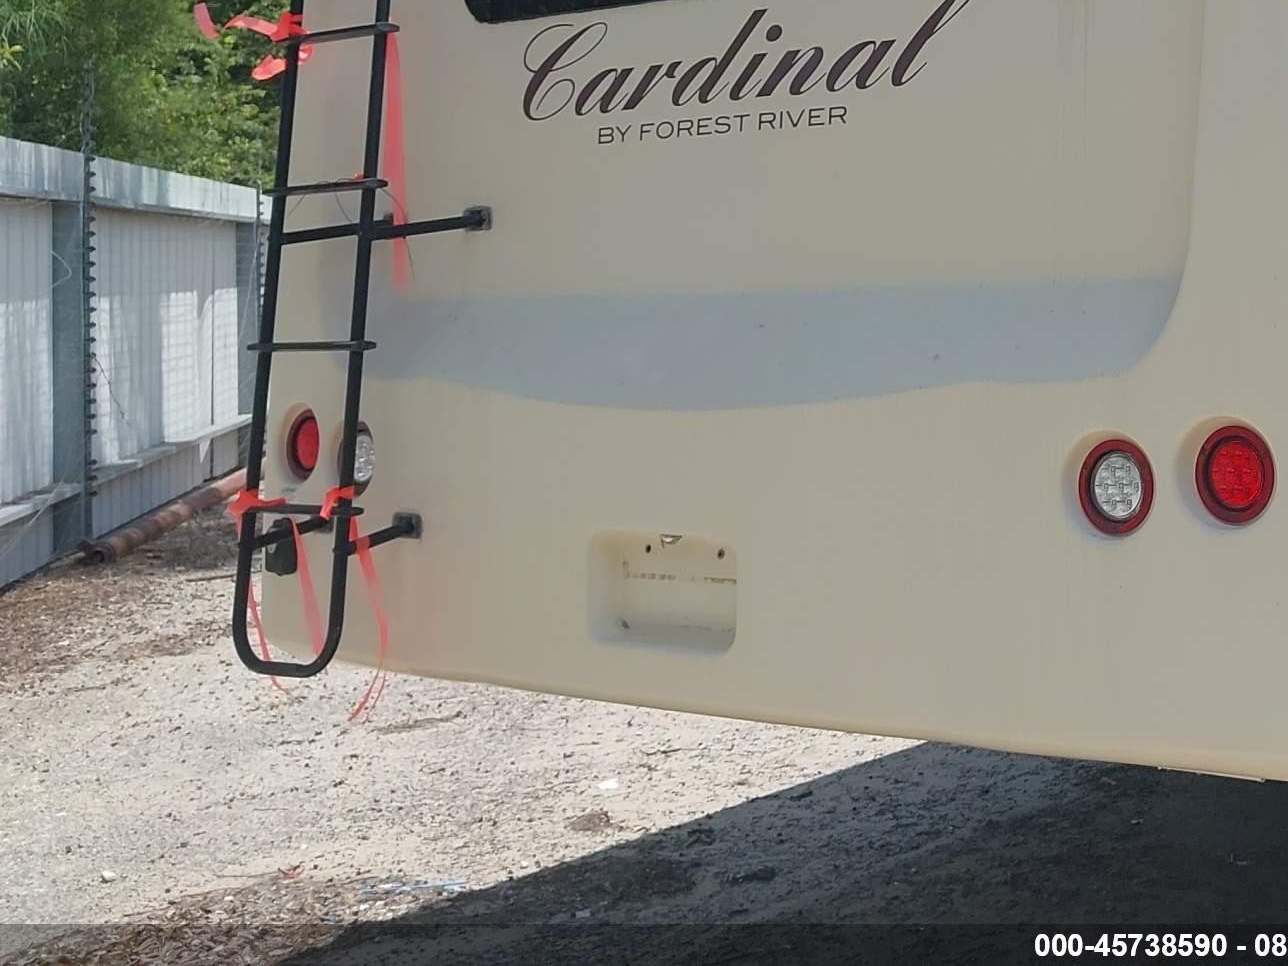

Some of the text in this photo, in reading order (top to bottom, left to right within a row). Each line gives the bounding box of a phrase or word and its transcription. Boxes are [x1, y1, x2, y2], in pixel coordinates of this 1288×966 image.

[597, 105, 848, 145] BY FOREST RIVER
